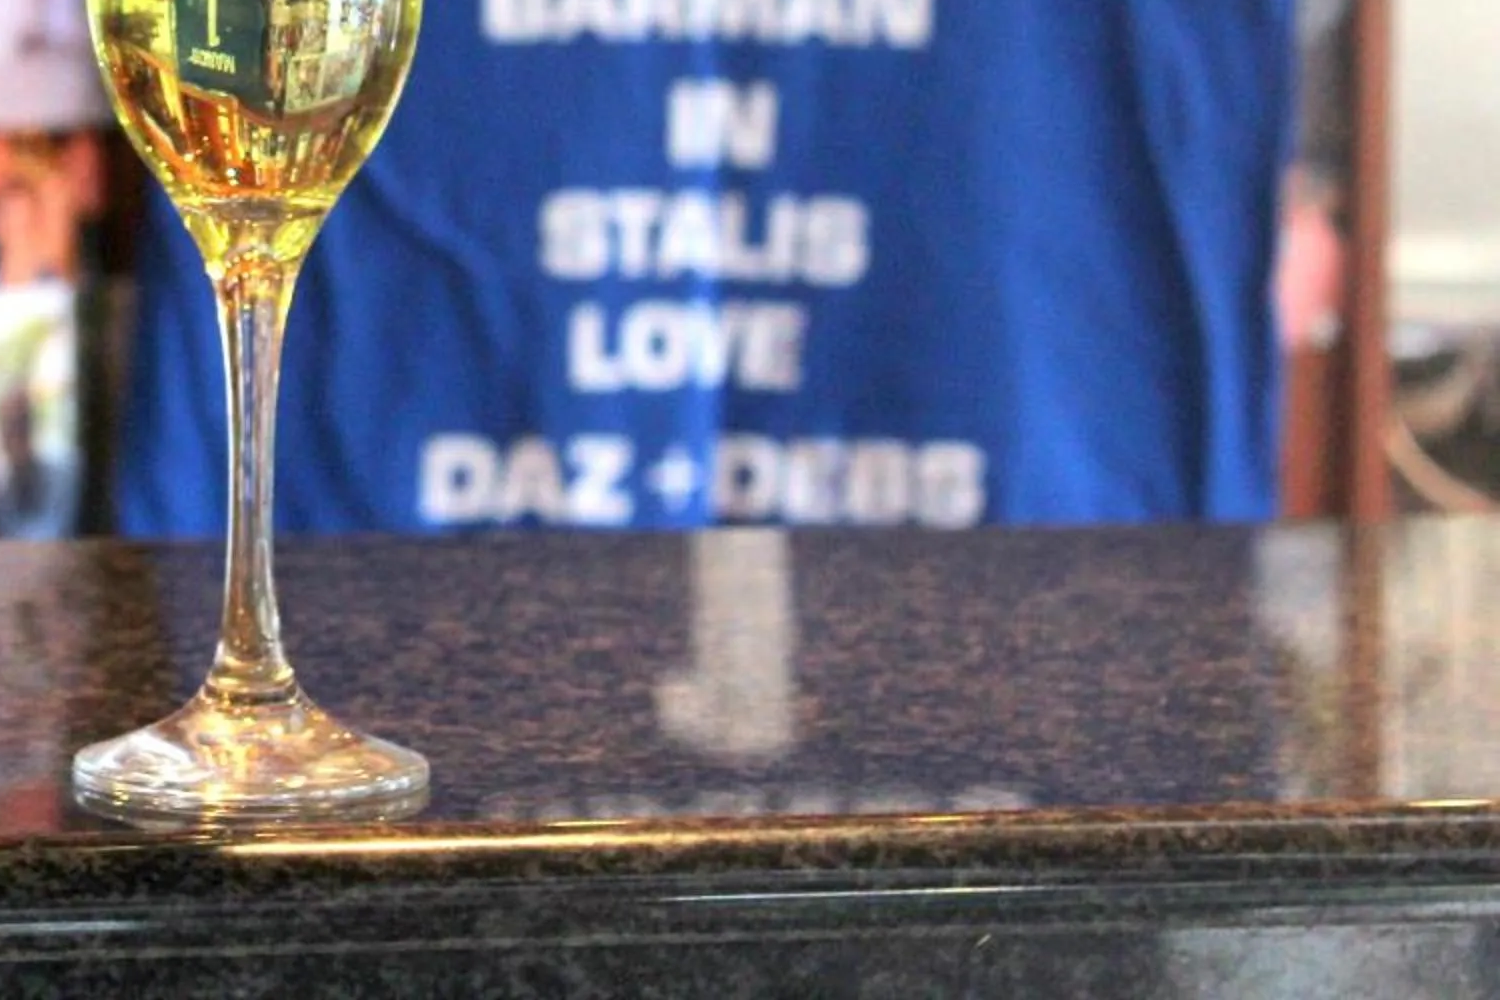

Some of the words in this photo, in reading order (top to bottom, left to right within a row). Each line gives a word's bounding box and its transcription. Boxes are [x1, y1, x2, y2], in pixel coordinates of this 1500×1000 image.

[667, 78, 778, 168] IN
[540, 189, 868, 284] STALIS
[567, 301, 805, 391] LOVE
[418, 435, 632, 526] DAZ
